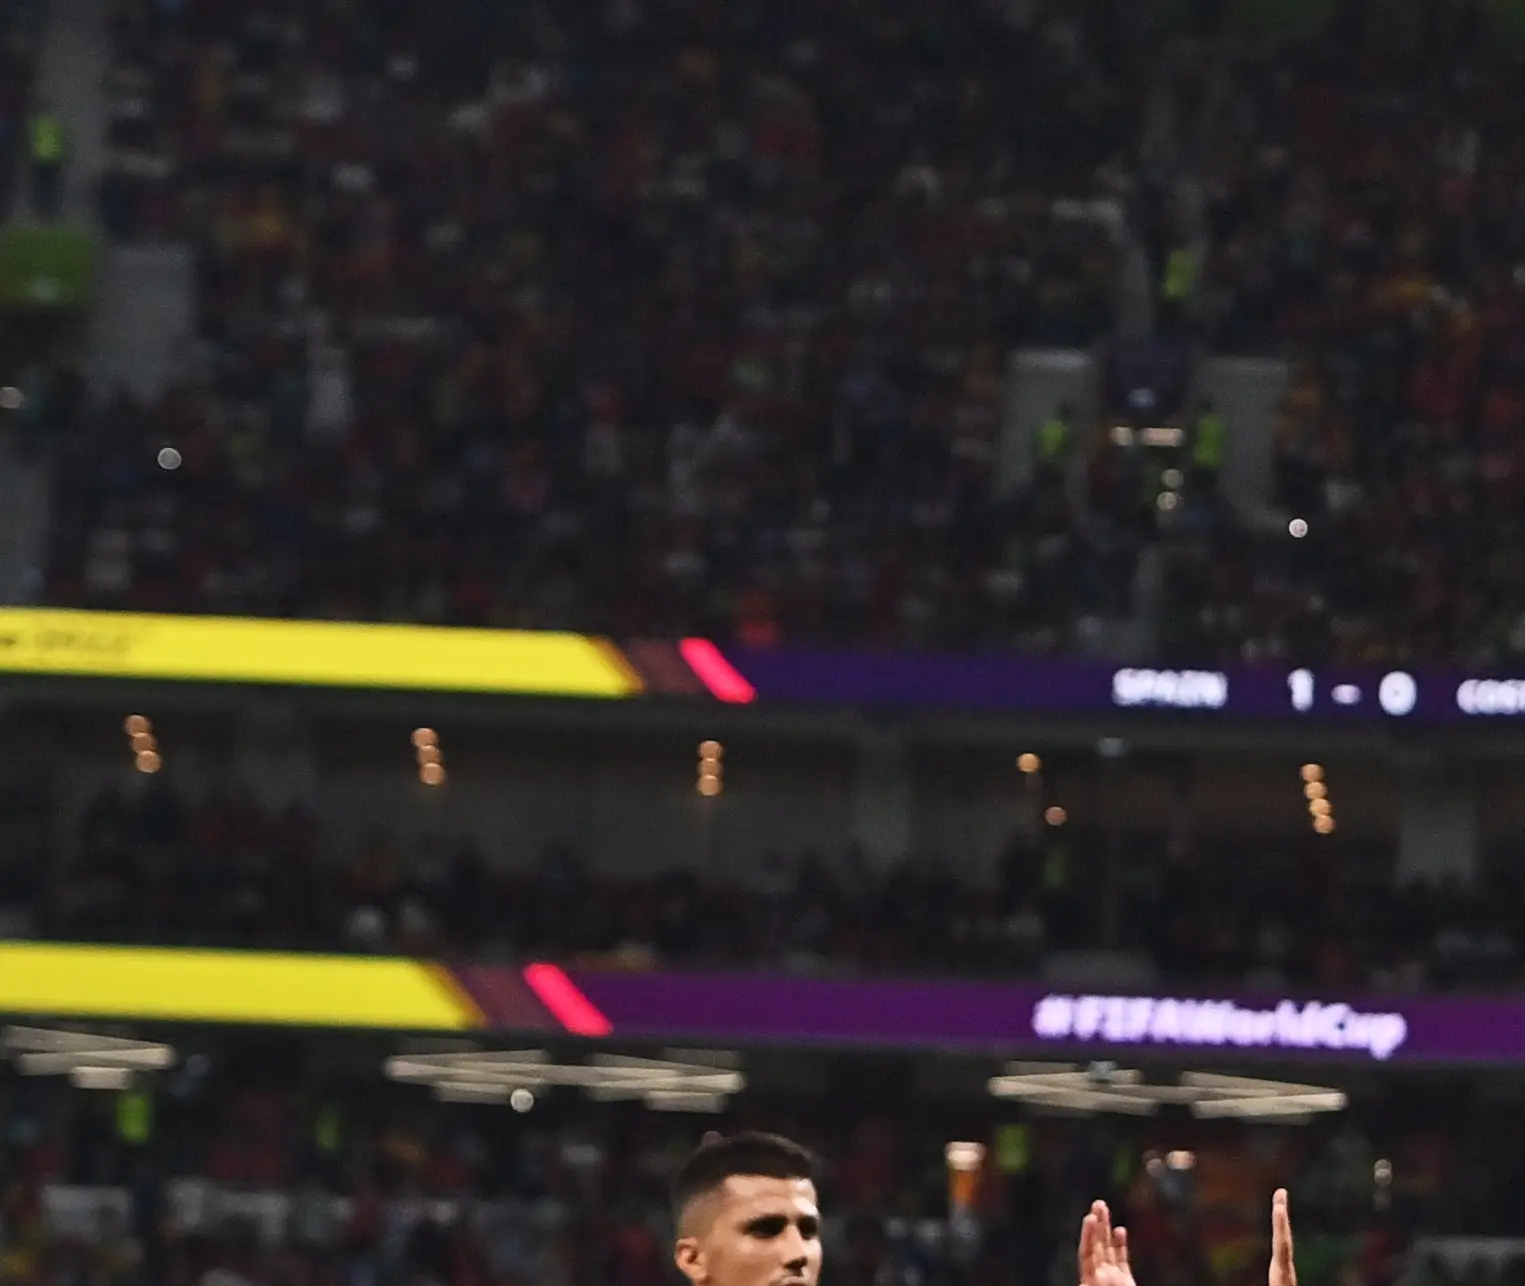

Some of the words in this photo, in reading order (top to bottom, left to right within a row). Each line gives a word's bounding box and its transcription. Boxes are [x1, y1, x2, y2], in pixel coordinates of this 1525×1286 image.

[1288, 668, 1314, 712] 1
[1379, 671, 1417, 716] 0
[1033, 994, 1407, 1059] #FIFAWorldCup
